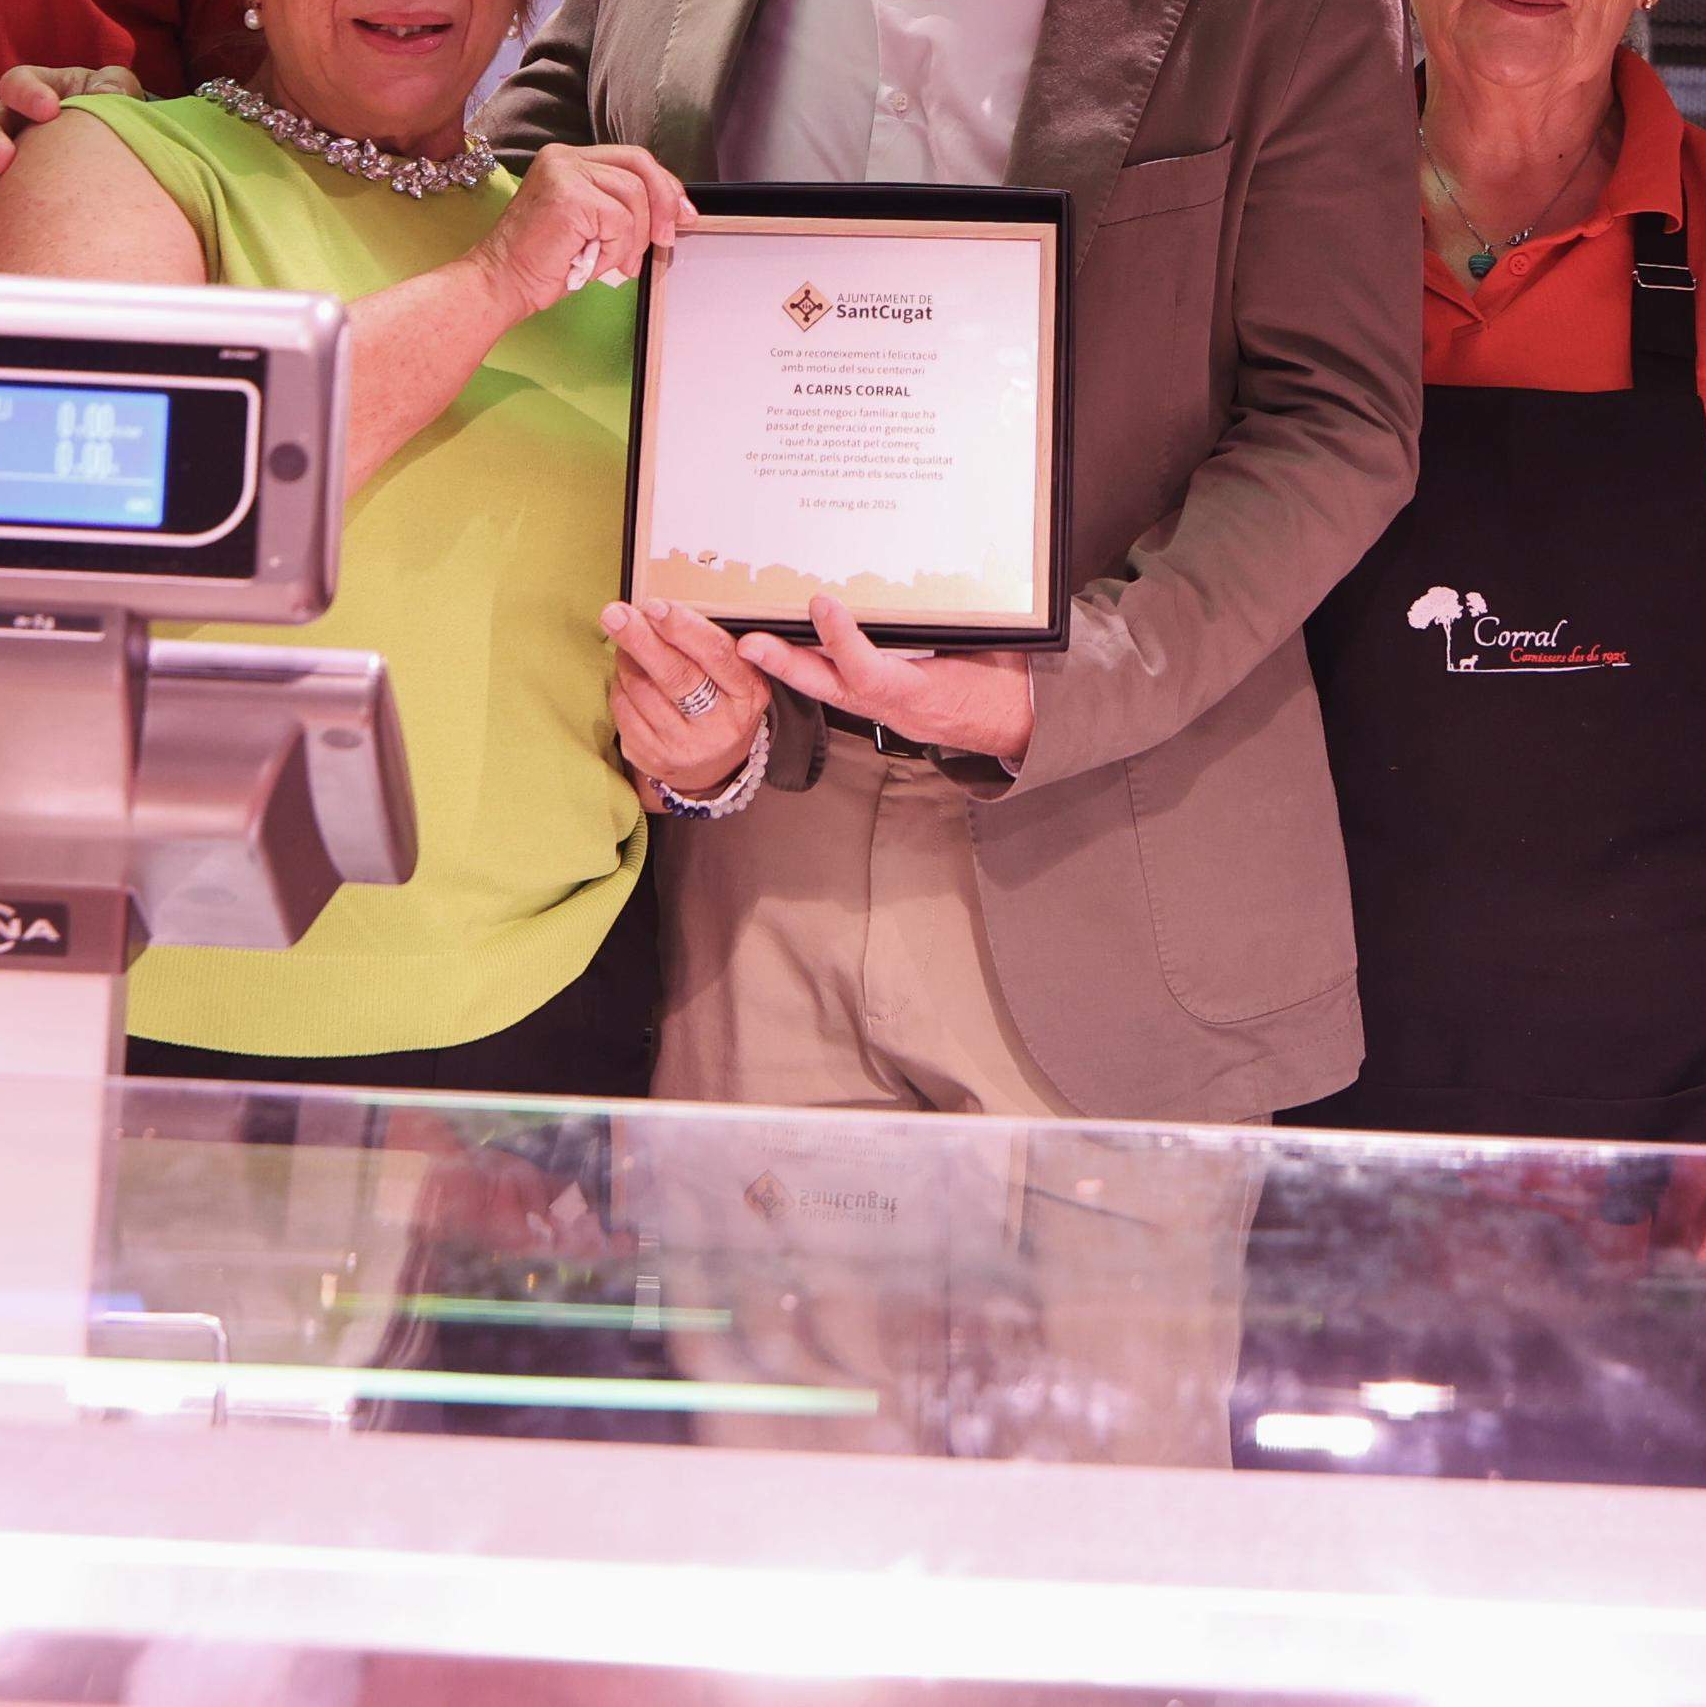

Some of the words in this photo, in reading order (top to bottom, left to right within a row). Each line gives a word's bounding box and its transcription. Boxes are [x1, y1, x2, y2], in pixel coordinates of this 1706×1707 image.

[837, 293, 914, 304] AJUNTAMENT
[919, 294, 933, 304] DE
[836, 304, 933, 324] SantCugat
[770, 347, 794, 358] Com
[804, 349, 880, 360] reconeixement
[887, 350, 938, 361] felicitació
[781, 363, 804, 373] amb
[806, 364, 836, 374] motiu
[838, 364, 855, 374] del
[857, 366, 874, 375] seu
[877, 366, 925, 376] centenari
[794, 384, 802, 394] A
[806, 384, 852, 395] CARNS
[856, 385, 911, 397] CORRAL
[766, 405, 784, 416] Per
[786, 407, 821, 419] aquest
[823, 408, 856, 420] negoci
[859, 408, 898, 418] familiar
[901, 411, 920, 421] que
[922, 409, 936, 419] ha
[766, 421, 799, 433] passat
[802, 421, 815, 431] de
[817, 423, 866, 435] generació
[869, 425, 882, 434] en
[884, 424, 935, 437] generació
[785, 439, 805, 449] que
[807, 437, 820, 447] ha
[822, 438, 861, 450] apostat
[863, 439, 879, 450] pel
[881, 441, 921, 452] comerç
[745, 452, 758, 461] de
[819, 453, 841, 464] pels
[843, 454, 895, 465] productes
[897, 455, 910, 464] de
[913, 455, 953, 467] qualitat
[759, 468, 776, 479] per
[779, 468, 798, 477] una
[801, 467, 839, 478] amistat
[842, 468, 865, 479] amb
[868, 469, 882, 479] els
[884, 471, 907, 480] seus
[909, 469, 944, 481] clients
[799, 497, 810, 508] 31
[813, 498, 826, 508] de
[829, 498, 854, 511] maig
[857, 499, 870, 509] de
[1474, 616, 1568, 647] Corral
